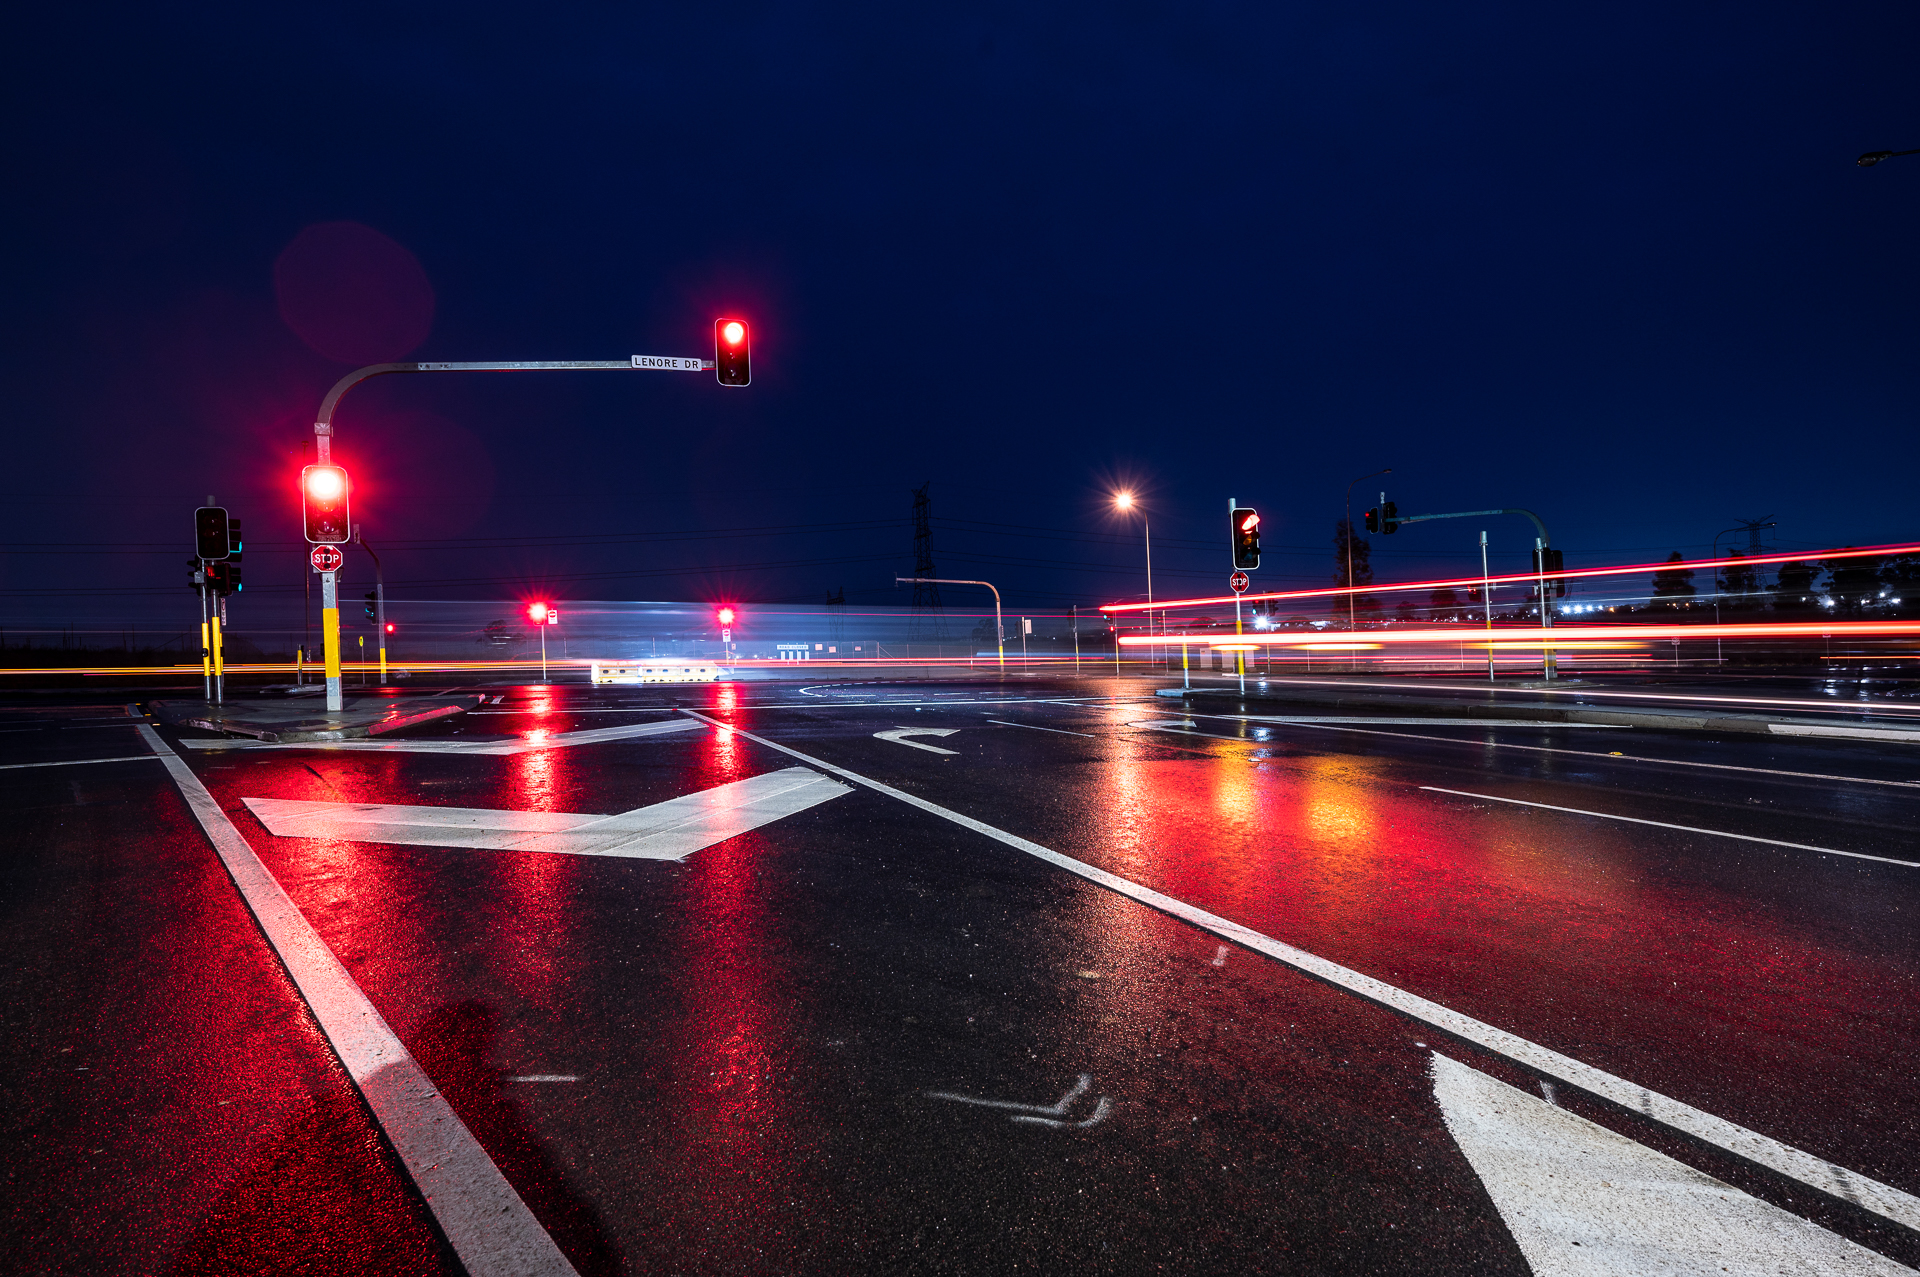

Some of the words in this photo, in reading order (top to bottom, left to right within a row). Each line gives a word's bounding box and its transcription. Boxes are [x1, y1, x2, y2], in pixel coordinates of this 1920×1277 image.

[634, 357, 678, 368] LENORE
[684, 360, 699, 369] DR
[314, 553, 340, 564] STOP
[1232, 577, 1247, 586] STOP
